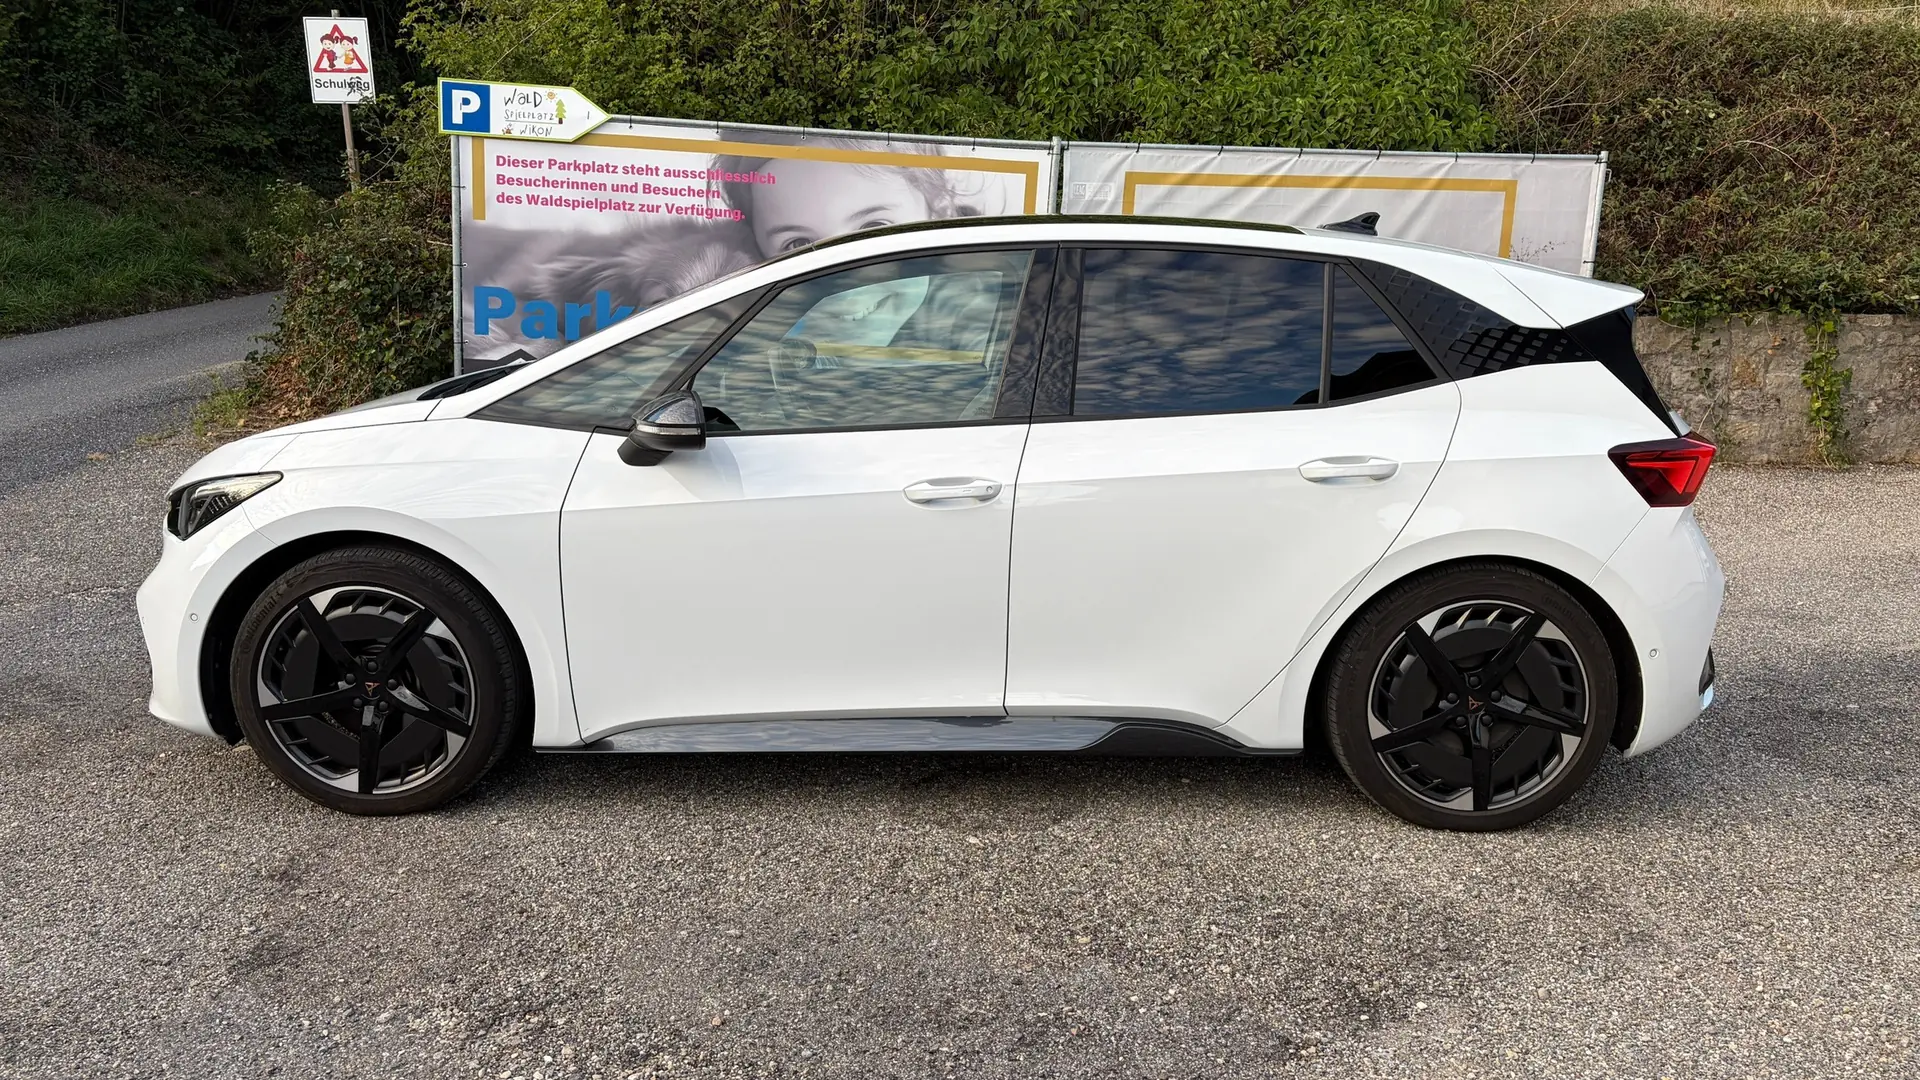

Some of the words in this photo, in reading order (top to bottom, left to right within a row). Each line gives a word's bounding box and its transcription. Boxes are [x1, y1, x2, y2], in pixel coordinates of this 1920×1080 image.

[452, 89, 481, 124] P
[496, 155, 544, 169] Dieser
[548, 158, 619, 175] Parkplatz
[622, 164, 660, 177] steht
[663, 168, 776, 185] ausschliesslich
[496, 174, 608, 191] Besucherinnen
[611, 182, 638, 194] und
[642, 183, 720, 199] Besuchern
[496, 192, 523, 205] des
[526, 194, 635, 212] Waldspielplatz
[638, 203, 662, 214] zur
[665, 203, 746, 222] Verfügung.
[473, 285, 651, 342] Park
